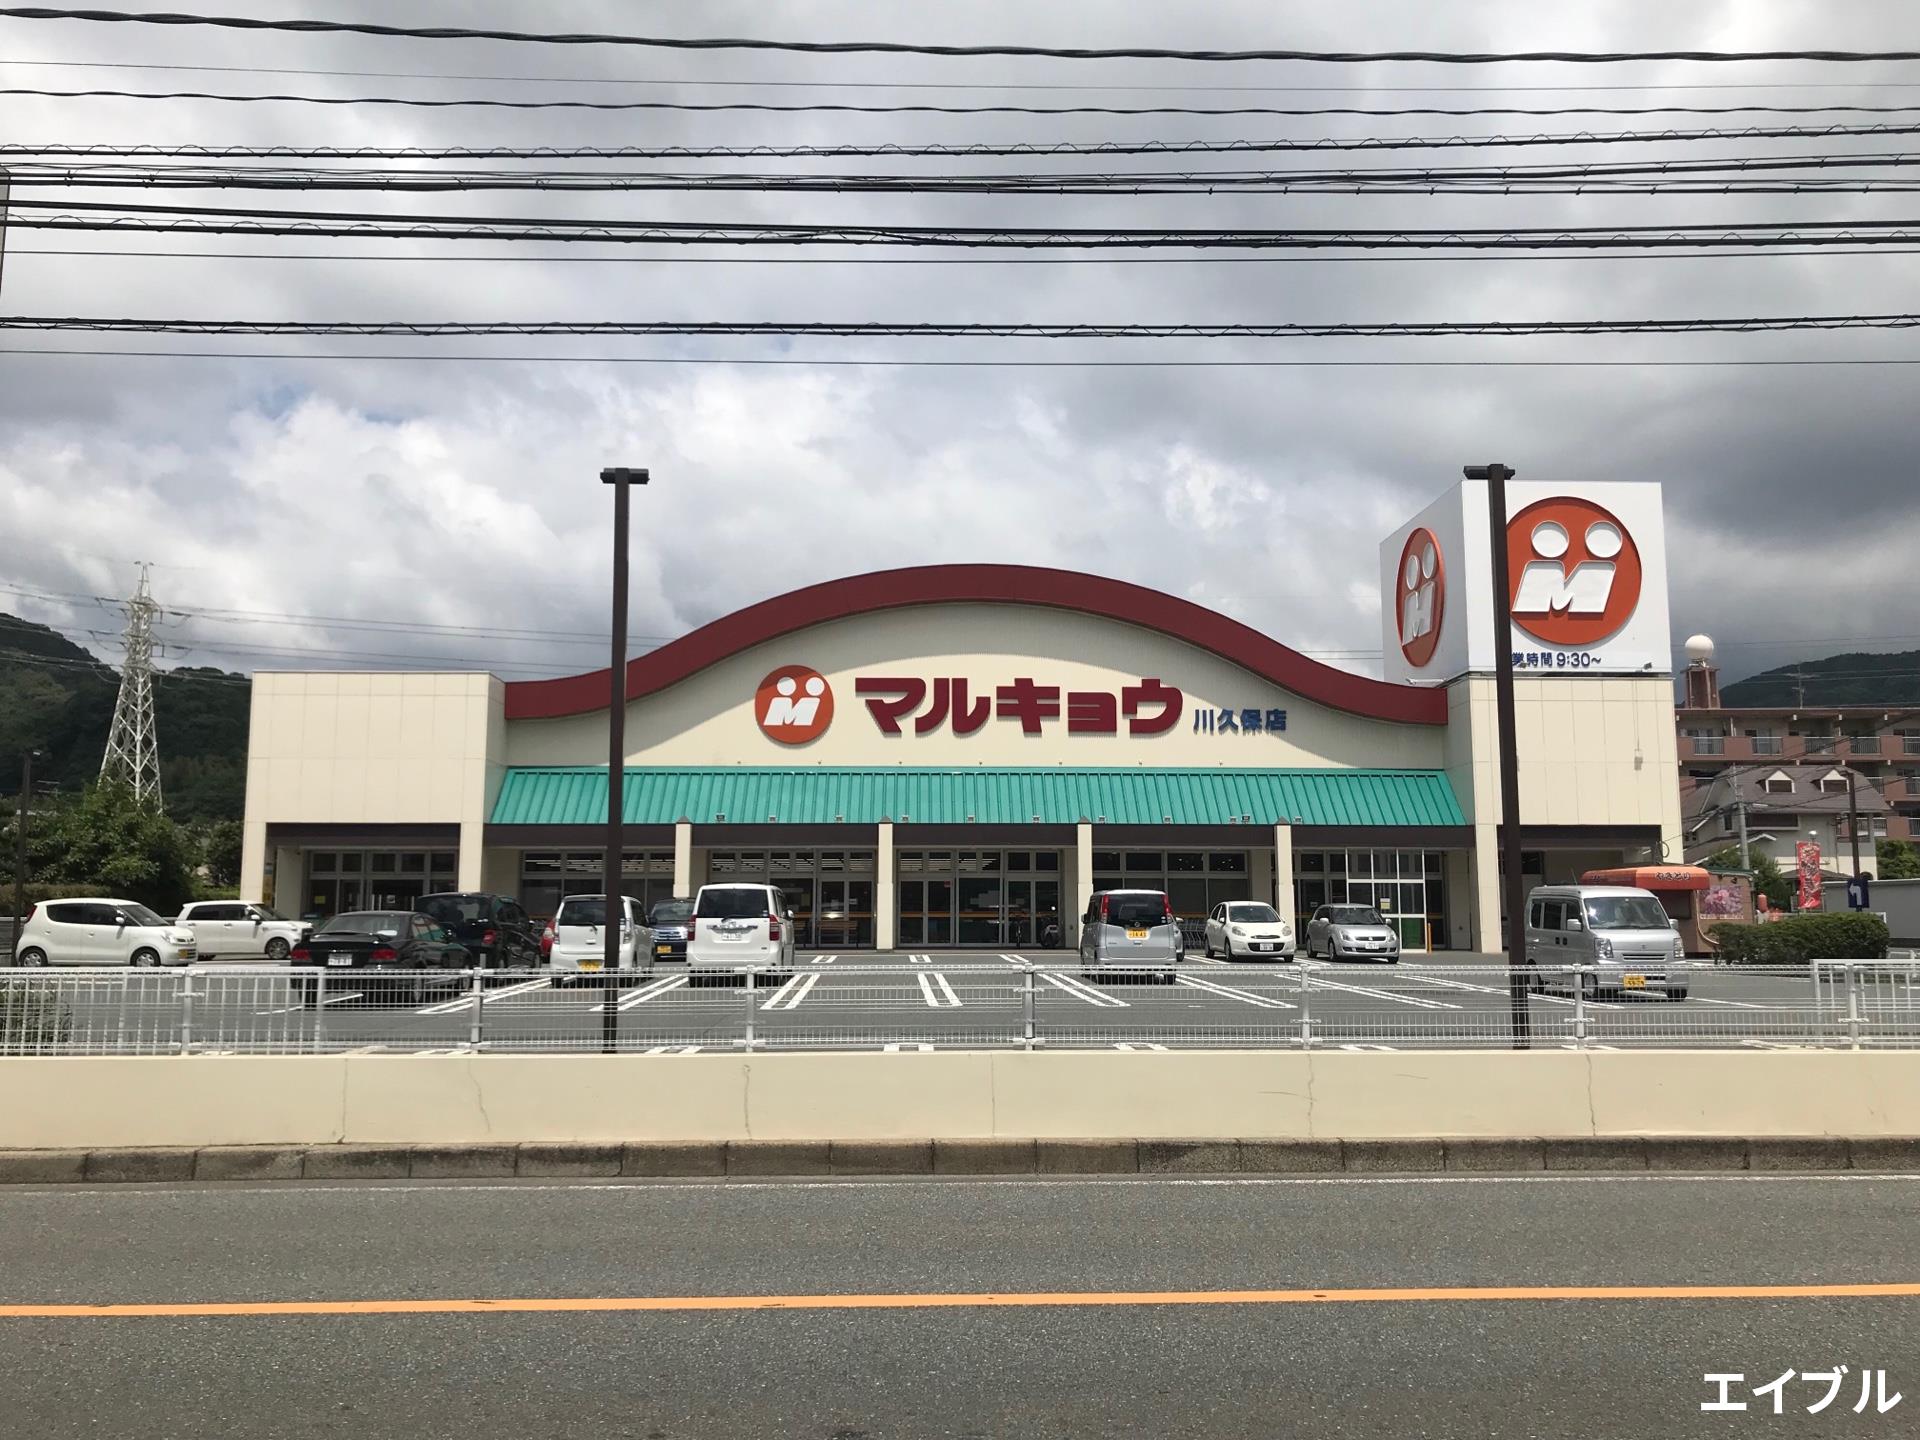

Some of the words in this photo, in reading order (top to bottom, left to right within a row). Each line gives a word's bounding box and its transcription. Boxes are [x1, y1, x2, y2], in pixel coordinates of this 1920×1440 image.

[855, 677, 1183, 735] マルキョウ
[1194, 708, 1288, 733] 川久保店
